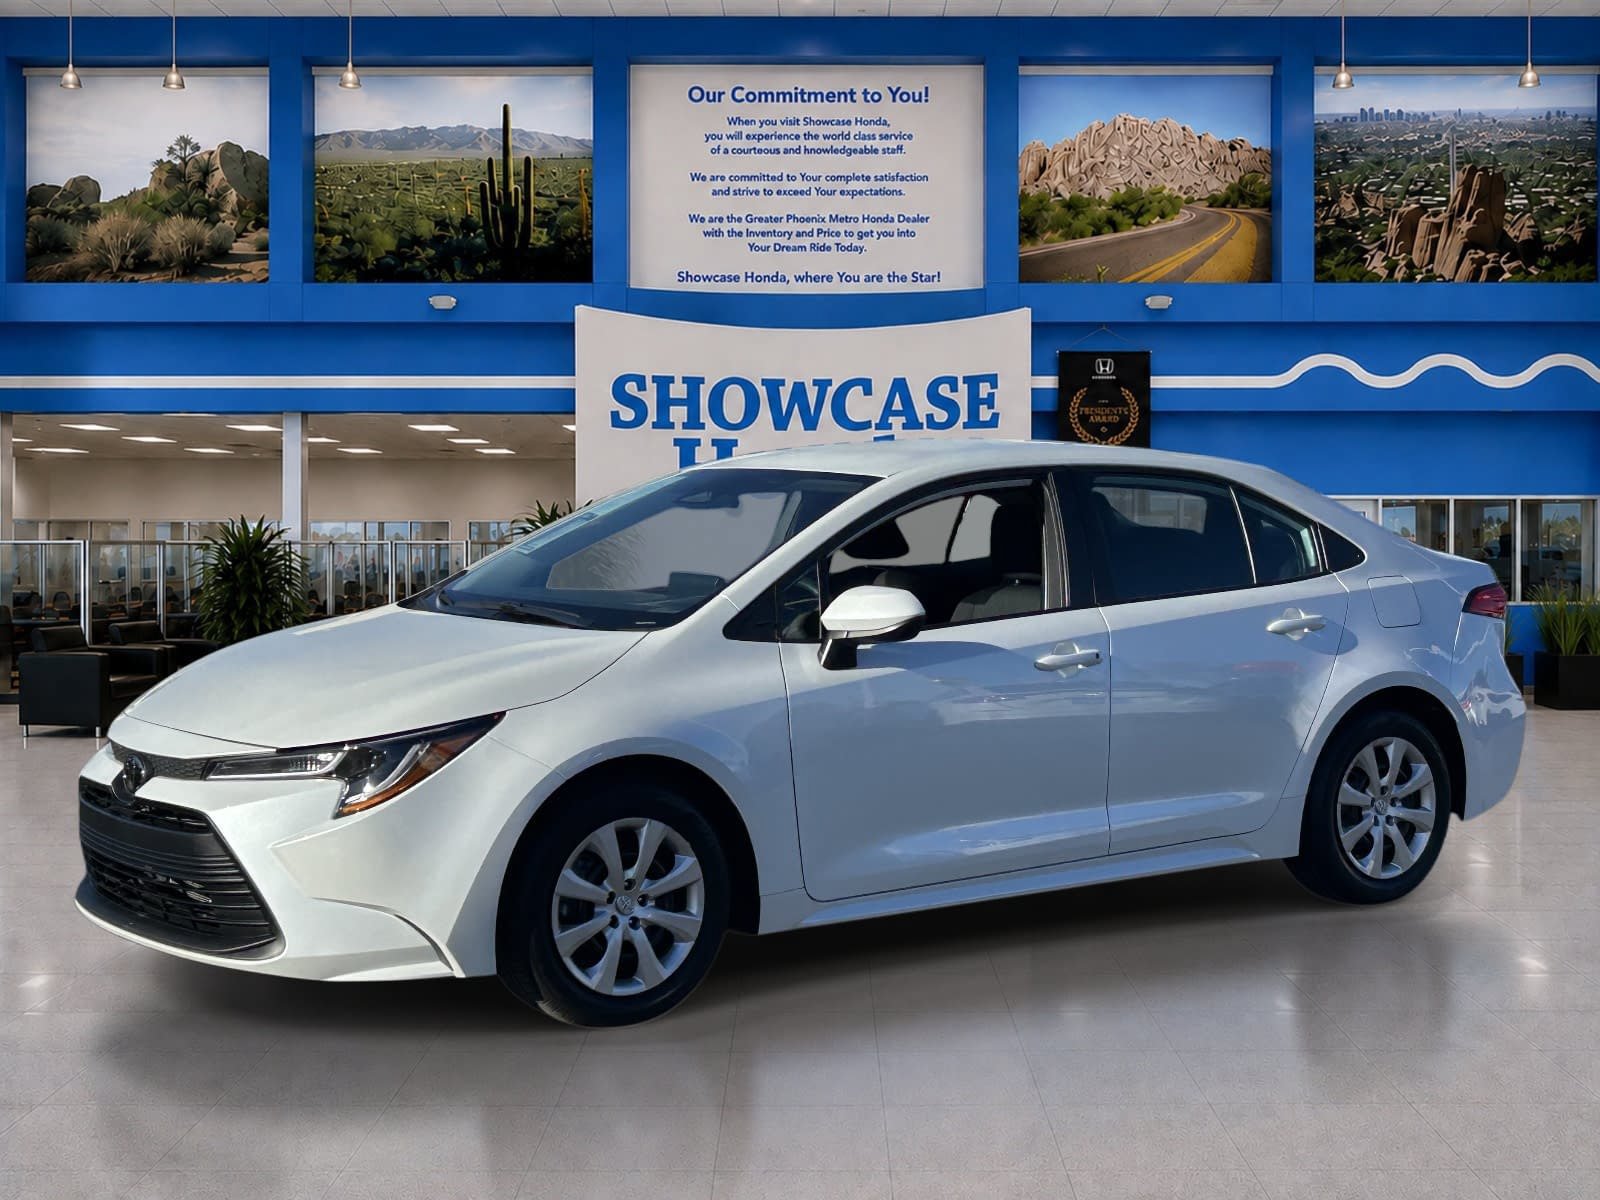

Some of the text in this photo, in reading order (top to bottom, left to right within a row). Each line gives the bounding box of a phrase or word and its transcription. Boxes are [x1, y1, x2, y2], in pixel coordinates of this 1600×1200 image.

[687, 86, 930, 103] Our Commitment to You!
[726, 116, 891, 128] When you visit Showcase Honda,
[704, 131, 914, 143] you will experience the world class service
[710, 145, 721, 154] of
[730, 147, 781, 155] courteous
[782, 145, 802, 154] and
[881, 144, 906, 154] staff.
[689, 173, 708, 182] We
[728, 172, 784, 182] committed
[786, 174, 798, 182] to
[799, 173, 823, 182] Your
[824, 172, 872, 184] complete
[873, 172, 929, 182] satisfaction
[711, 186, 906, 199] and strive to exceed Your expectations.
[688, 214, 706, 223] We
[725, 214, 743, 223] the
[744, 214, 785, 223] Greater
[785, 214, 827, 223] Phoenix
[828, 214, 860, 223] Metro
[861, 214, 895, 223] Honda
[897, 214, 931, 223] Dealer
[702, 228, 917, 240] with the Inventory and Price to get you into
[747, 243, 868, 254] Your Dream Ride Today.
[677, 271, 941, 285] Showcase Honda, where You are the Star!
[610, 372, 1000, 432] SHOWCASE
